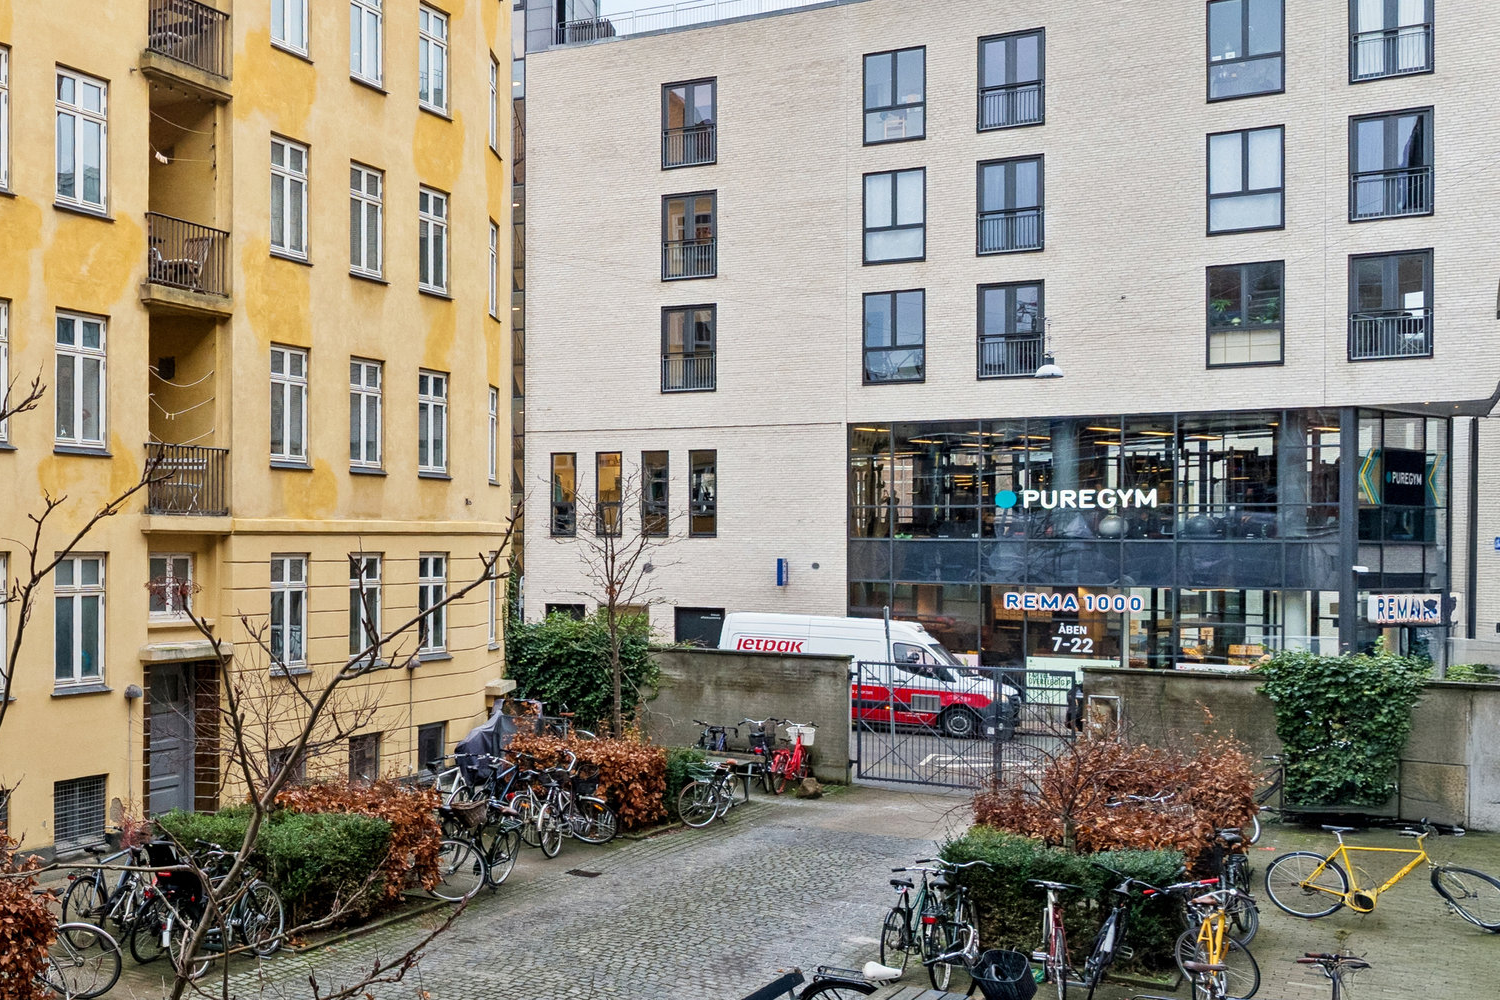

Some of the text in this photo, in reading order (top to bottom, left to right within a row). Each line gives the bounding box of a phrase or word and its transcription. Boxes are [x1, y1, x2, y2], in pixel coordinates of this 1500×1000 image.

[1391, 471, 1423, 485] PUREGYM
[1023, 488, 1157, 509] PUREGYM
[1004, 592, 1145, 613] REMA 1000
[1058, 622, 1087, 635] ÅBEN
[1052, 637, 1094, 654] 7-22
